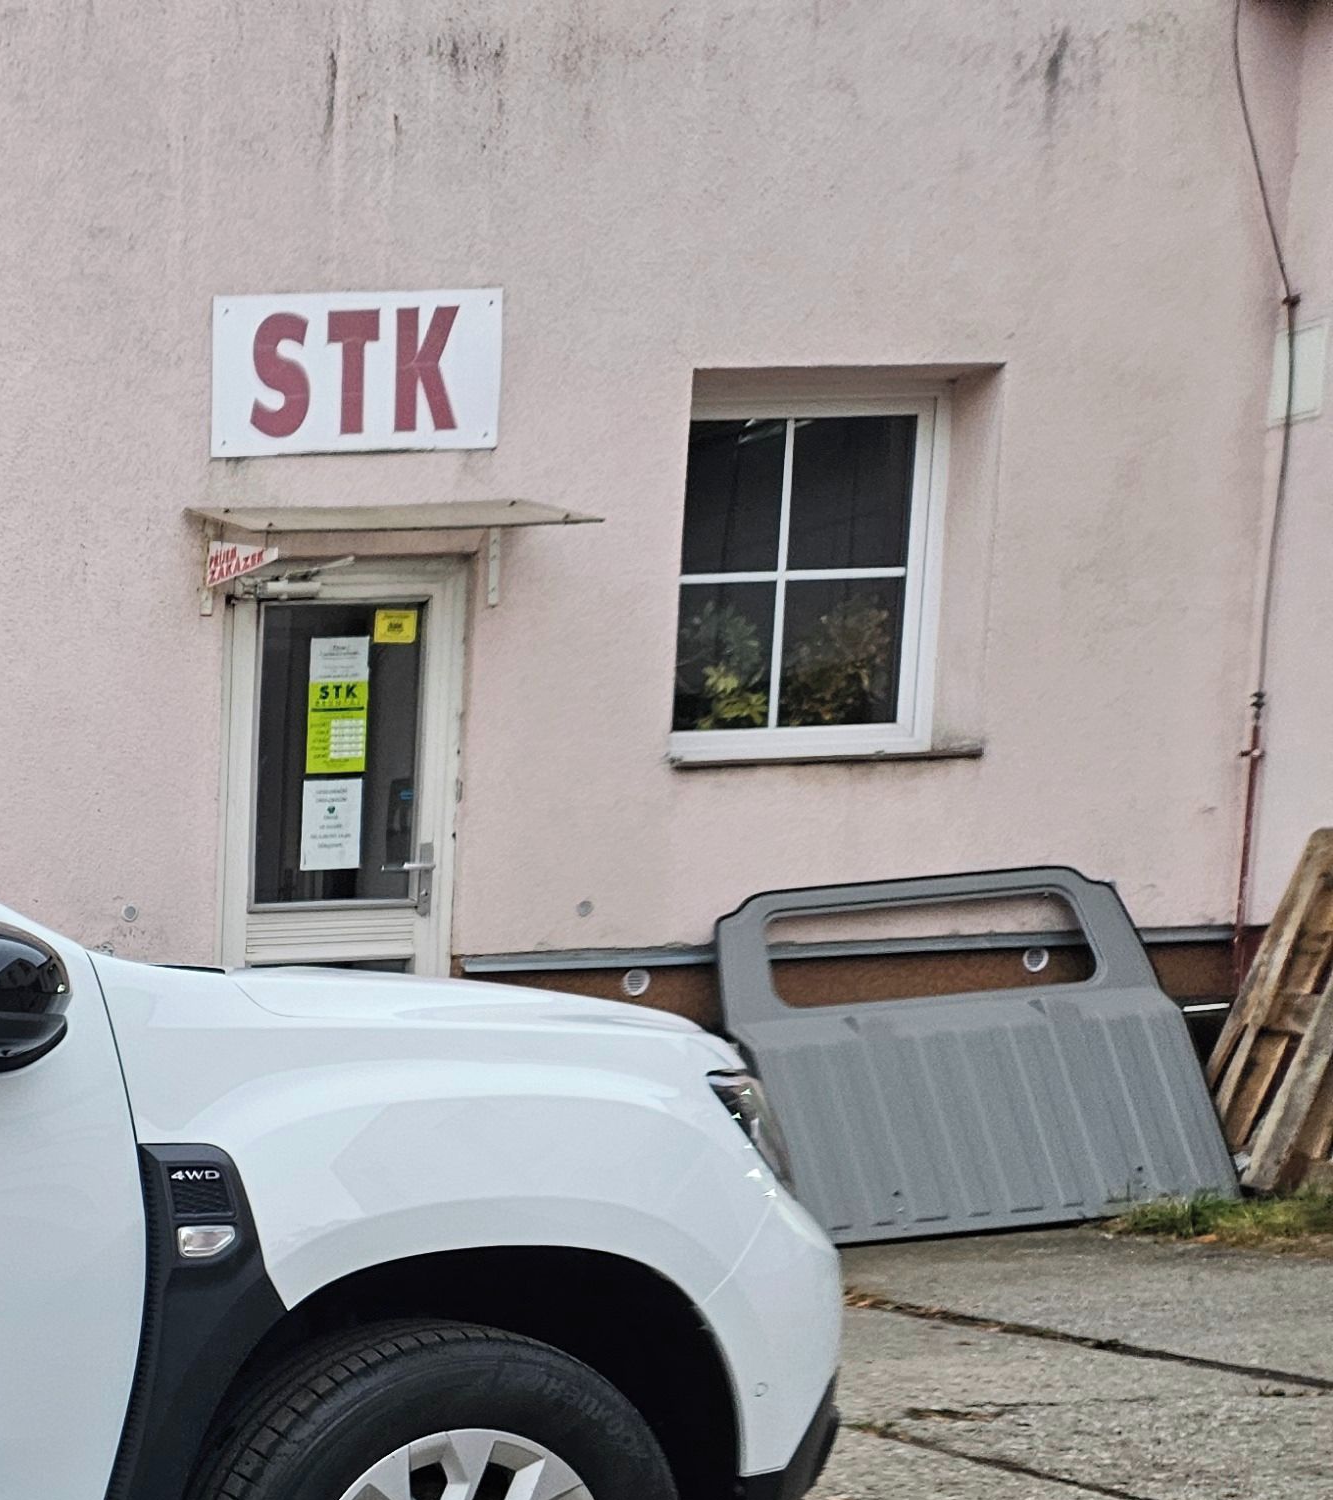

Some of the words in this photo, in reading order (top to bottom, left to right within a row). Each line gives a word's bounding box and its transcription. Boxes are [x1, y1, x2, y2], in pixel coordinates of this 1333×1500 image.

[249, 304, 461, 439] STK
[319, 684, 358, 700] STK
[171, 1169, 220, 1181] 4WD
